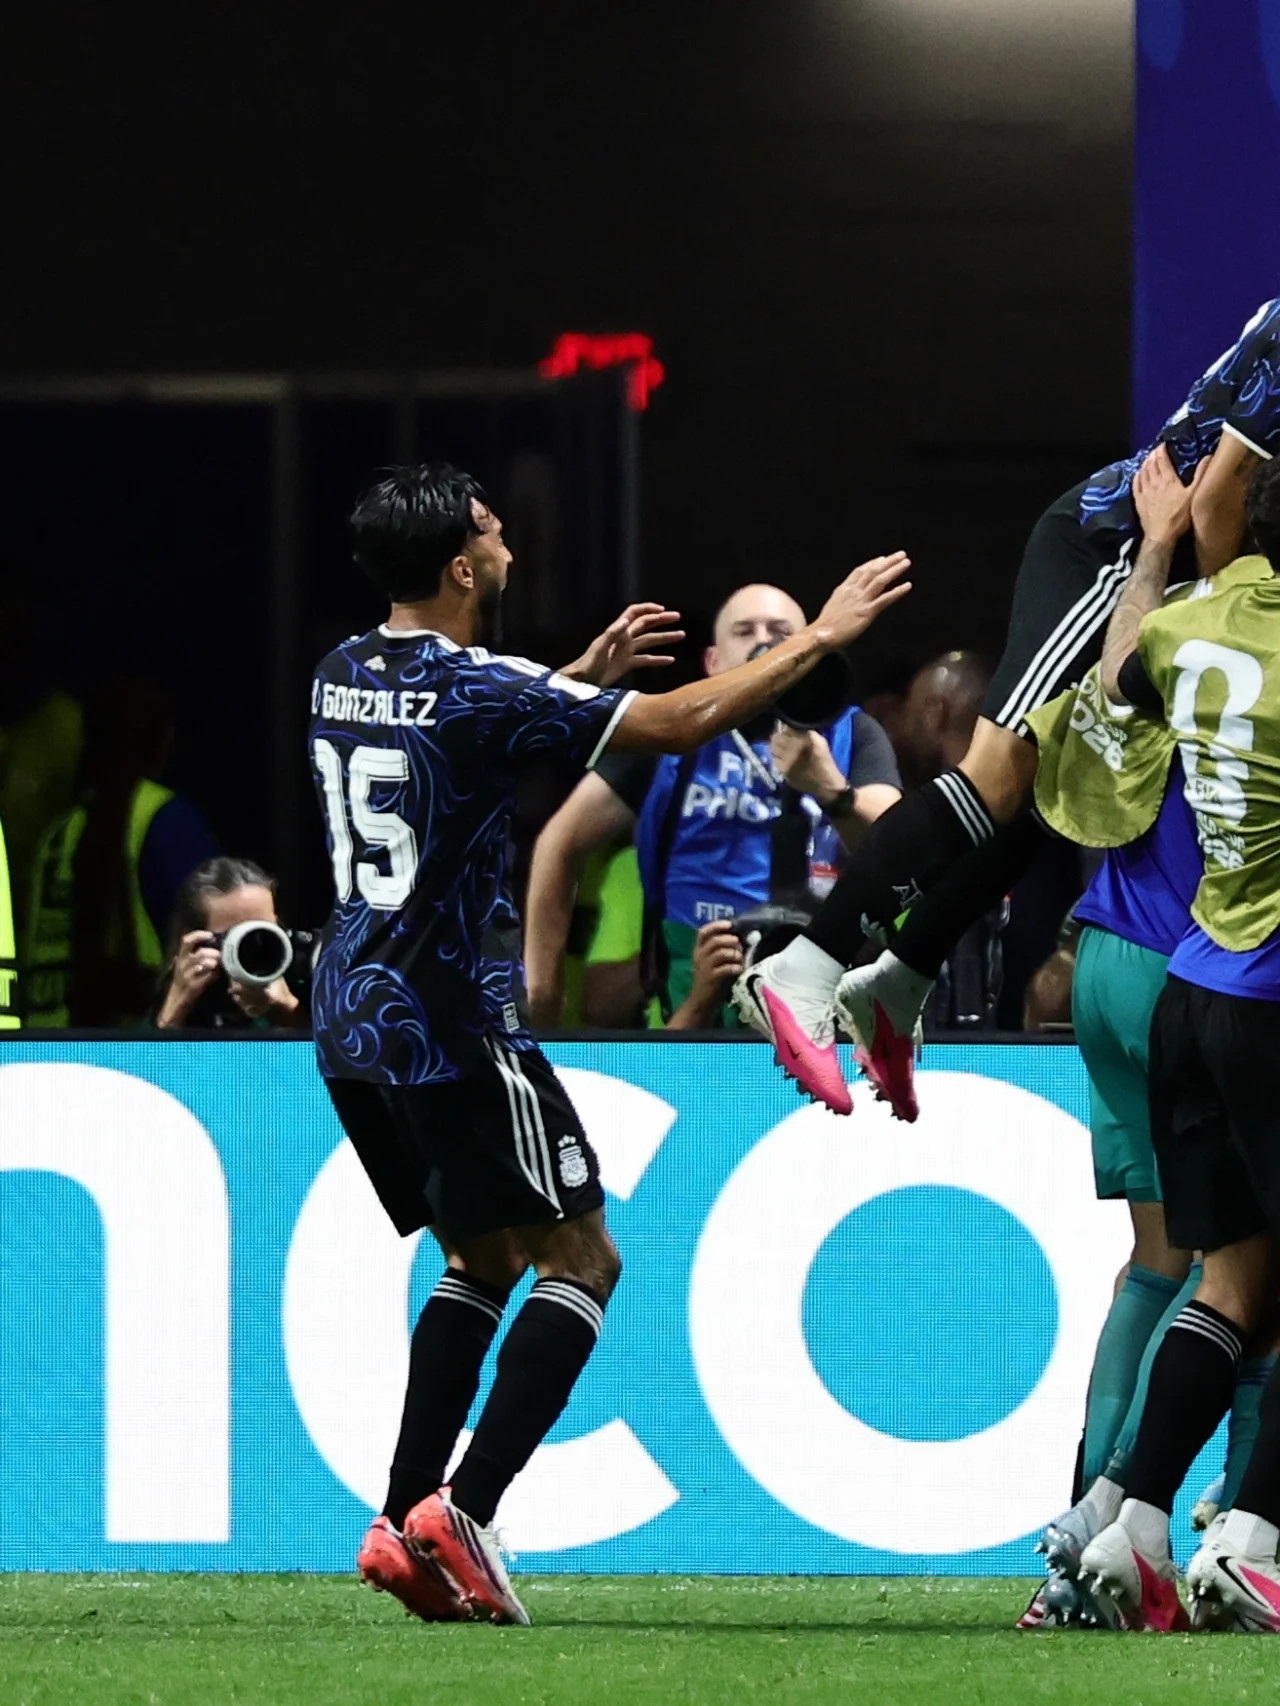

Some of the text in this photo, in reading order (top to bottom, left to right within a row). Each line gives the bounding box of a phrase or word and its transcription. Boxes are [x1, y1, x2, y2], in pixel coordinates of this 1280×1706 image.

[322, 682, 438, 727] GONZALEZ
[1069, 699, 1126, 772] 026
[313, 738, 419, 912] 15
[683, 783, 782, 823] PHO
